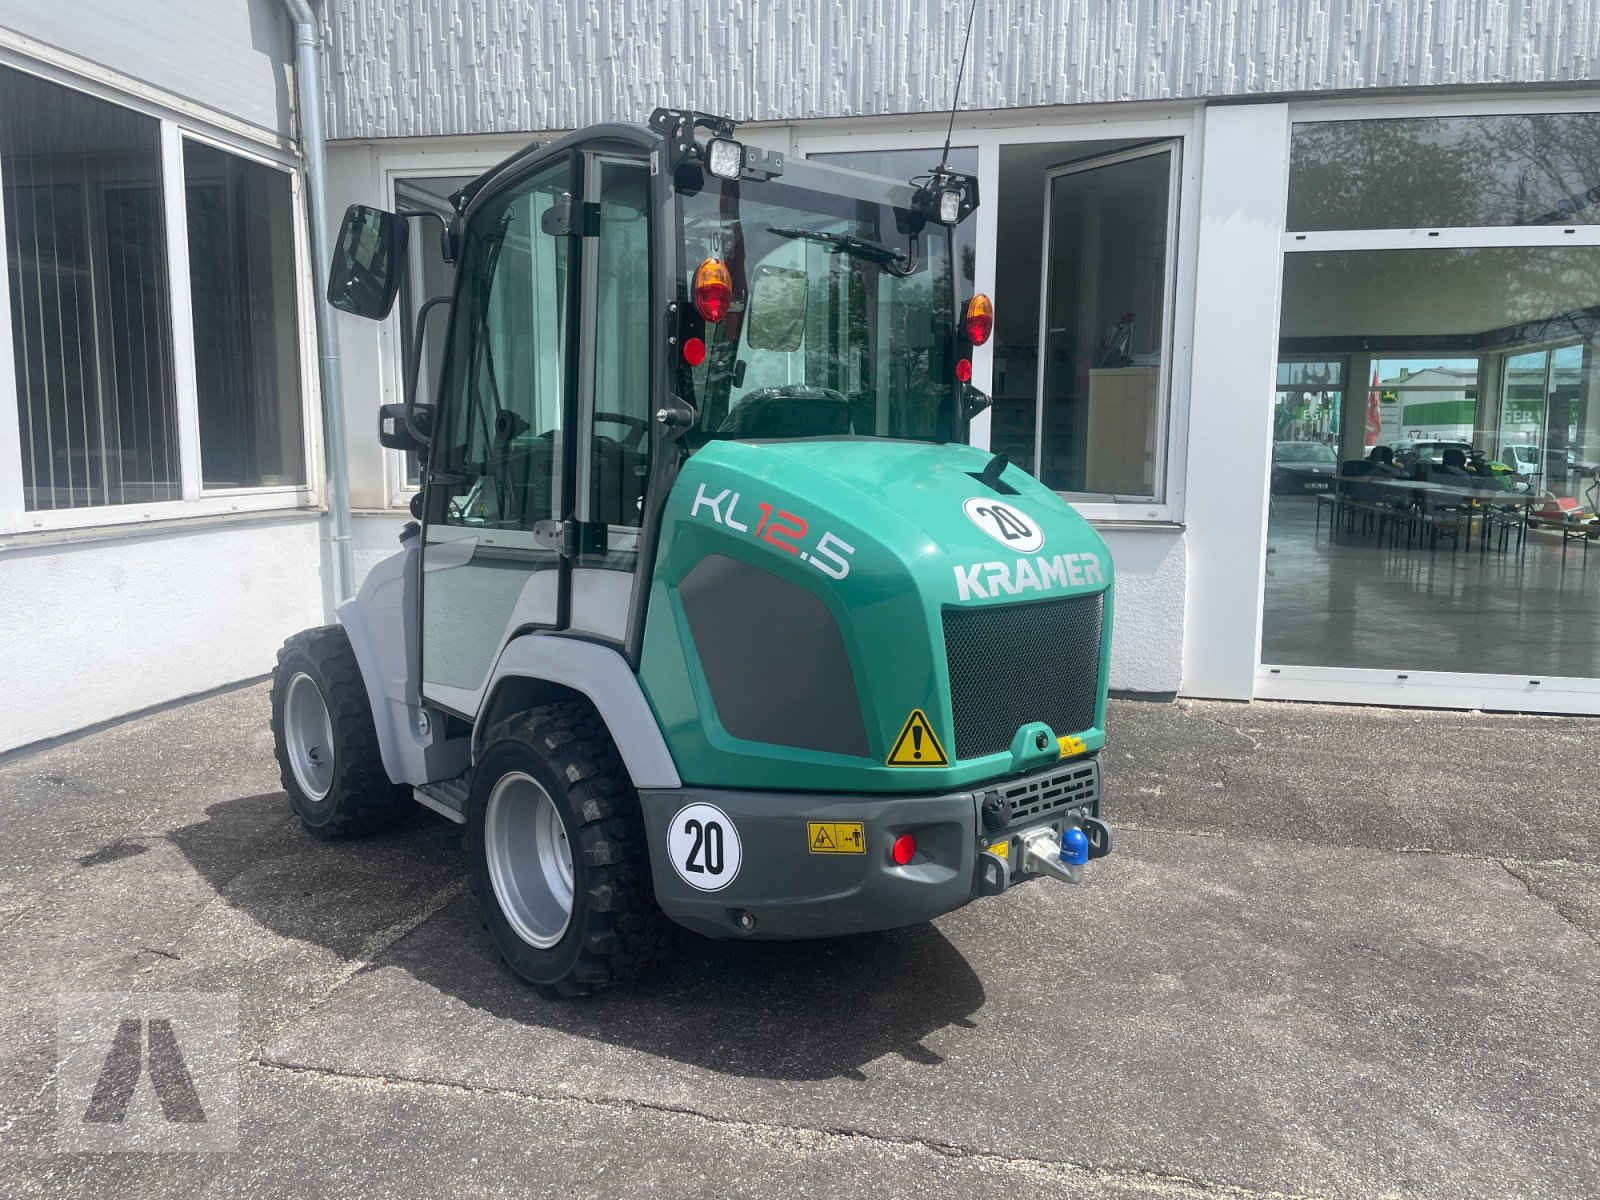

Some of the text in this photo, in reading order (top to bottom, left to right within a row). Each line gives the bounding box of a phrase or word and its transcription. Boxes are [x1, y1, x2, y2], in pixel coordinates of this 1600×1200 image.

[691, 483, 855, 580] KL12.5
[976, 505, 1032, 540] 20
[953, 552, 1104, 601] KRAMER
[685, 819, 724, 875] 20
